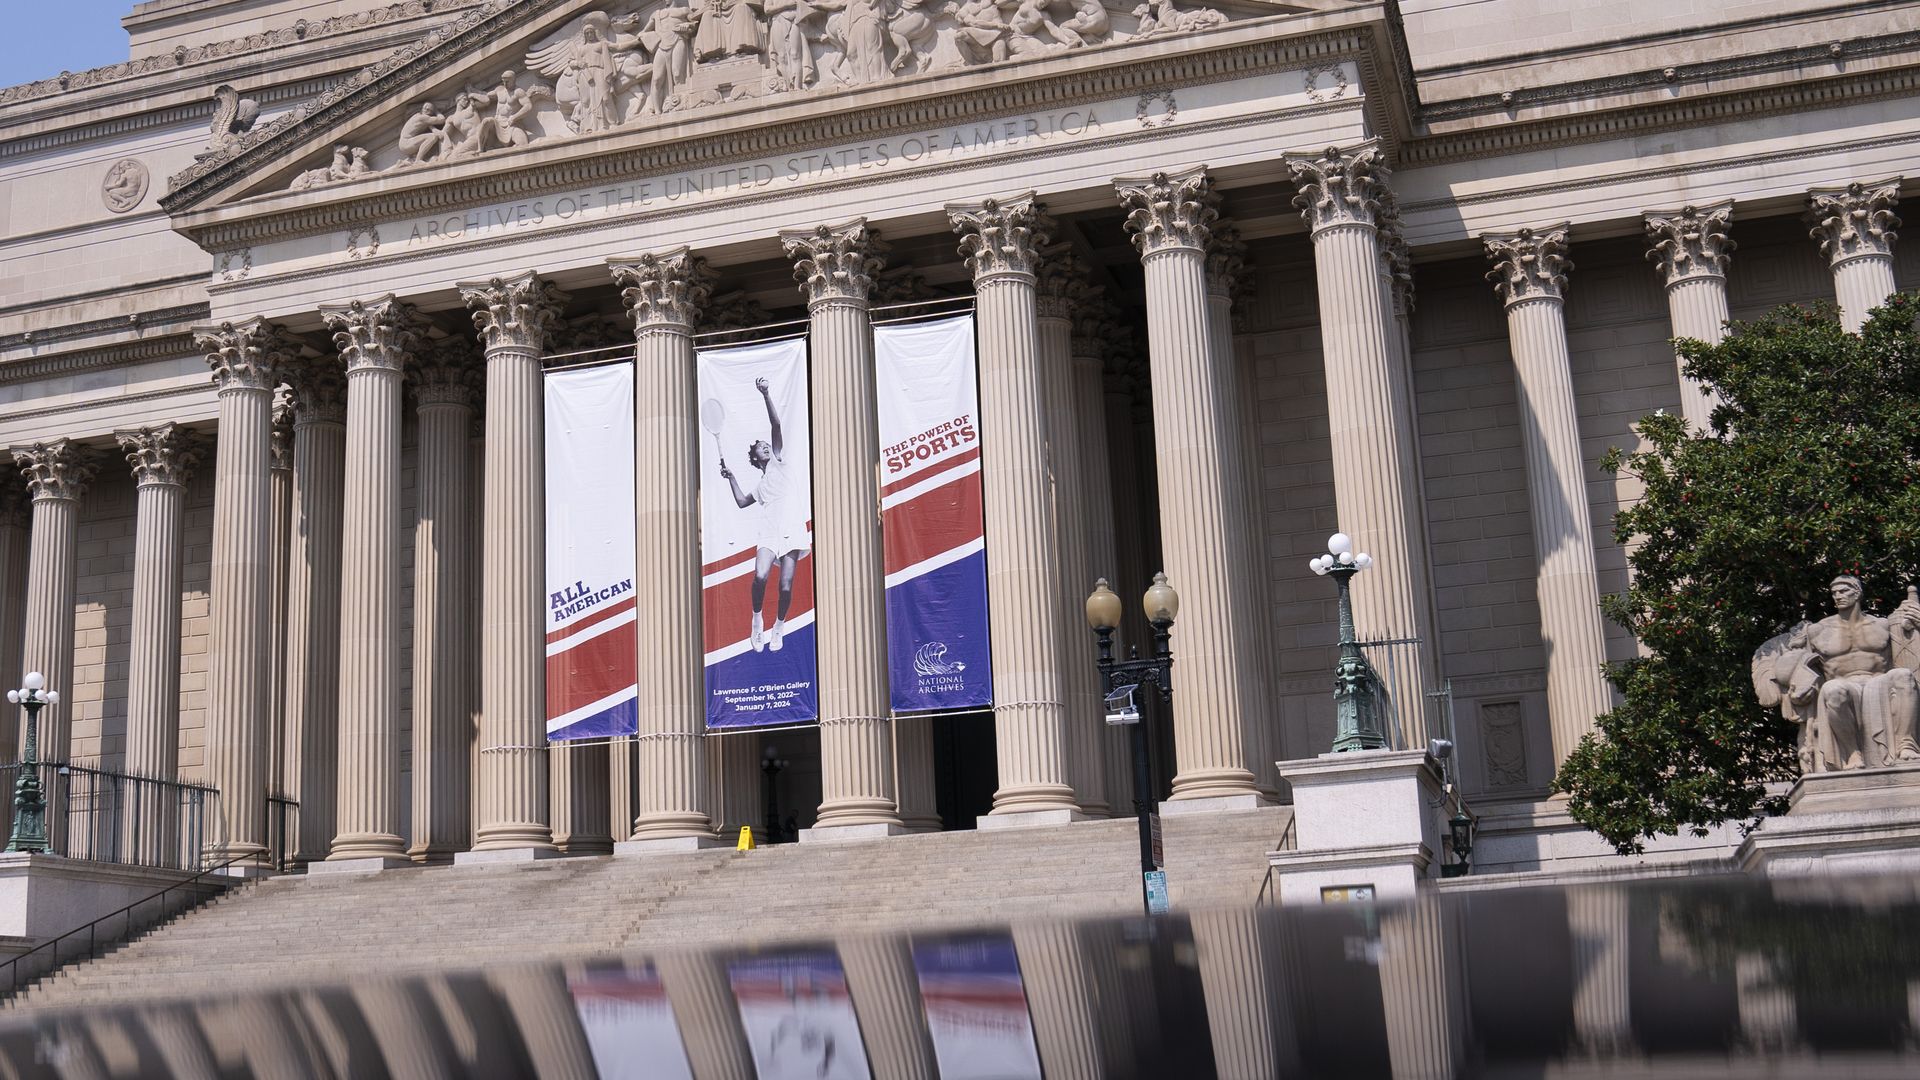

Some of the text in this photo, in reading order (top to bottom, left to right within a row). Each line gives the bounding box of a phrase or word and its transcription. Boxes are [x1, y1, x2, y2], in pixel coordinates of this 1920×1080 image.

[408, 108, 1103, 246] ARCHIVES OF THE UNITED STATES OF AMERICA
[883, 414, 970, 457] THE POWER OF
[887, 425, 976, 474] SPORTS
[550, 581, 590, 609] ALL
[554, 579, 632, 622] AMERICAN
[918, 676, 964, 686] NATIONAL
[918, 684, 964, 694] ARCHIVES
[725, 694, 766, 704] September
[766, 693, 776, 701] 16,
[736, 704, 766, 712] January
[773, 700, 791, 708] 2024
